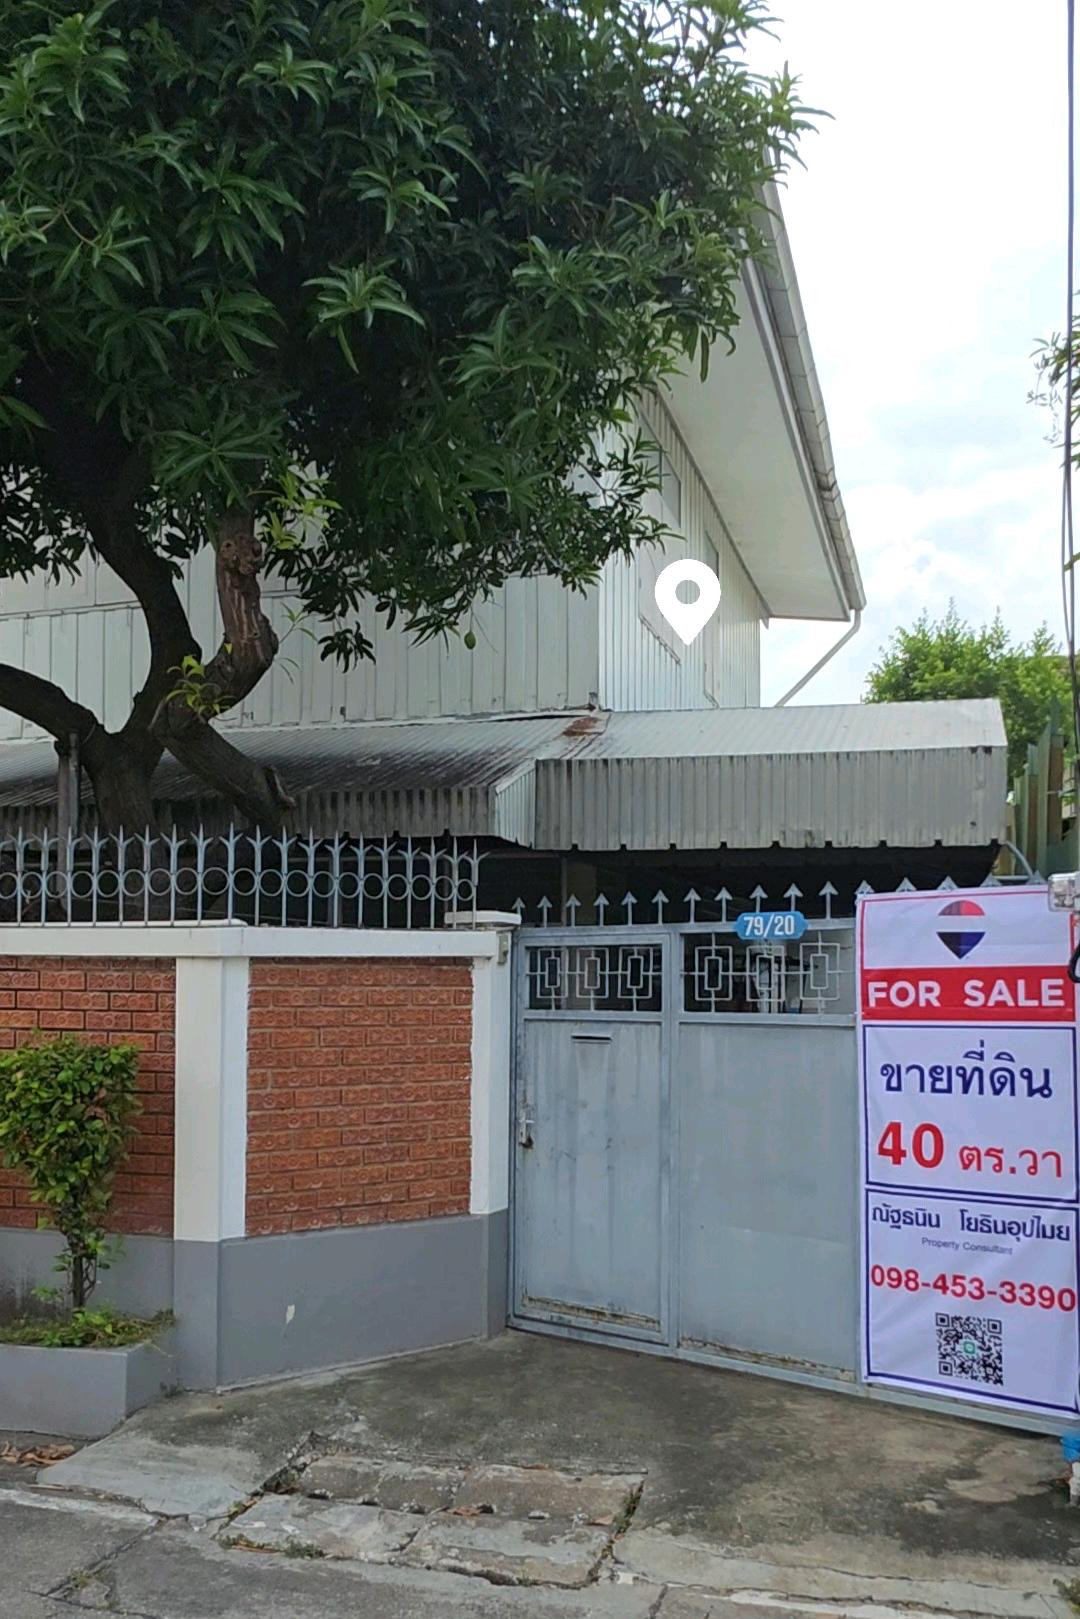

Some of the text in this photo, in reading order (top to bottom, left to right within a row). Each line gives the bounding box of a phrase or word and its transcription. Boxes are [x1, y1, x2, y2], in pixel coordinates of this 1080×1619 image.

[743, 913, 795, 938] 79/20
[867, 978, 1065, 1008] FOR SALE
[880, 1040, 1053, 1099] ขายที่ดิน
[877, 1121, 1063, 1178] 40 ตร.วา
[921, 1237, 1013, 1255] Property Consultant
[871, 1264, 1076, 1312] 098-453-3390
